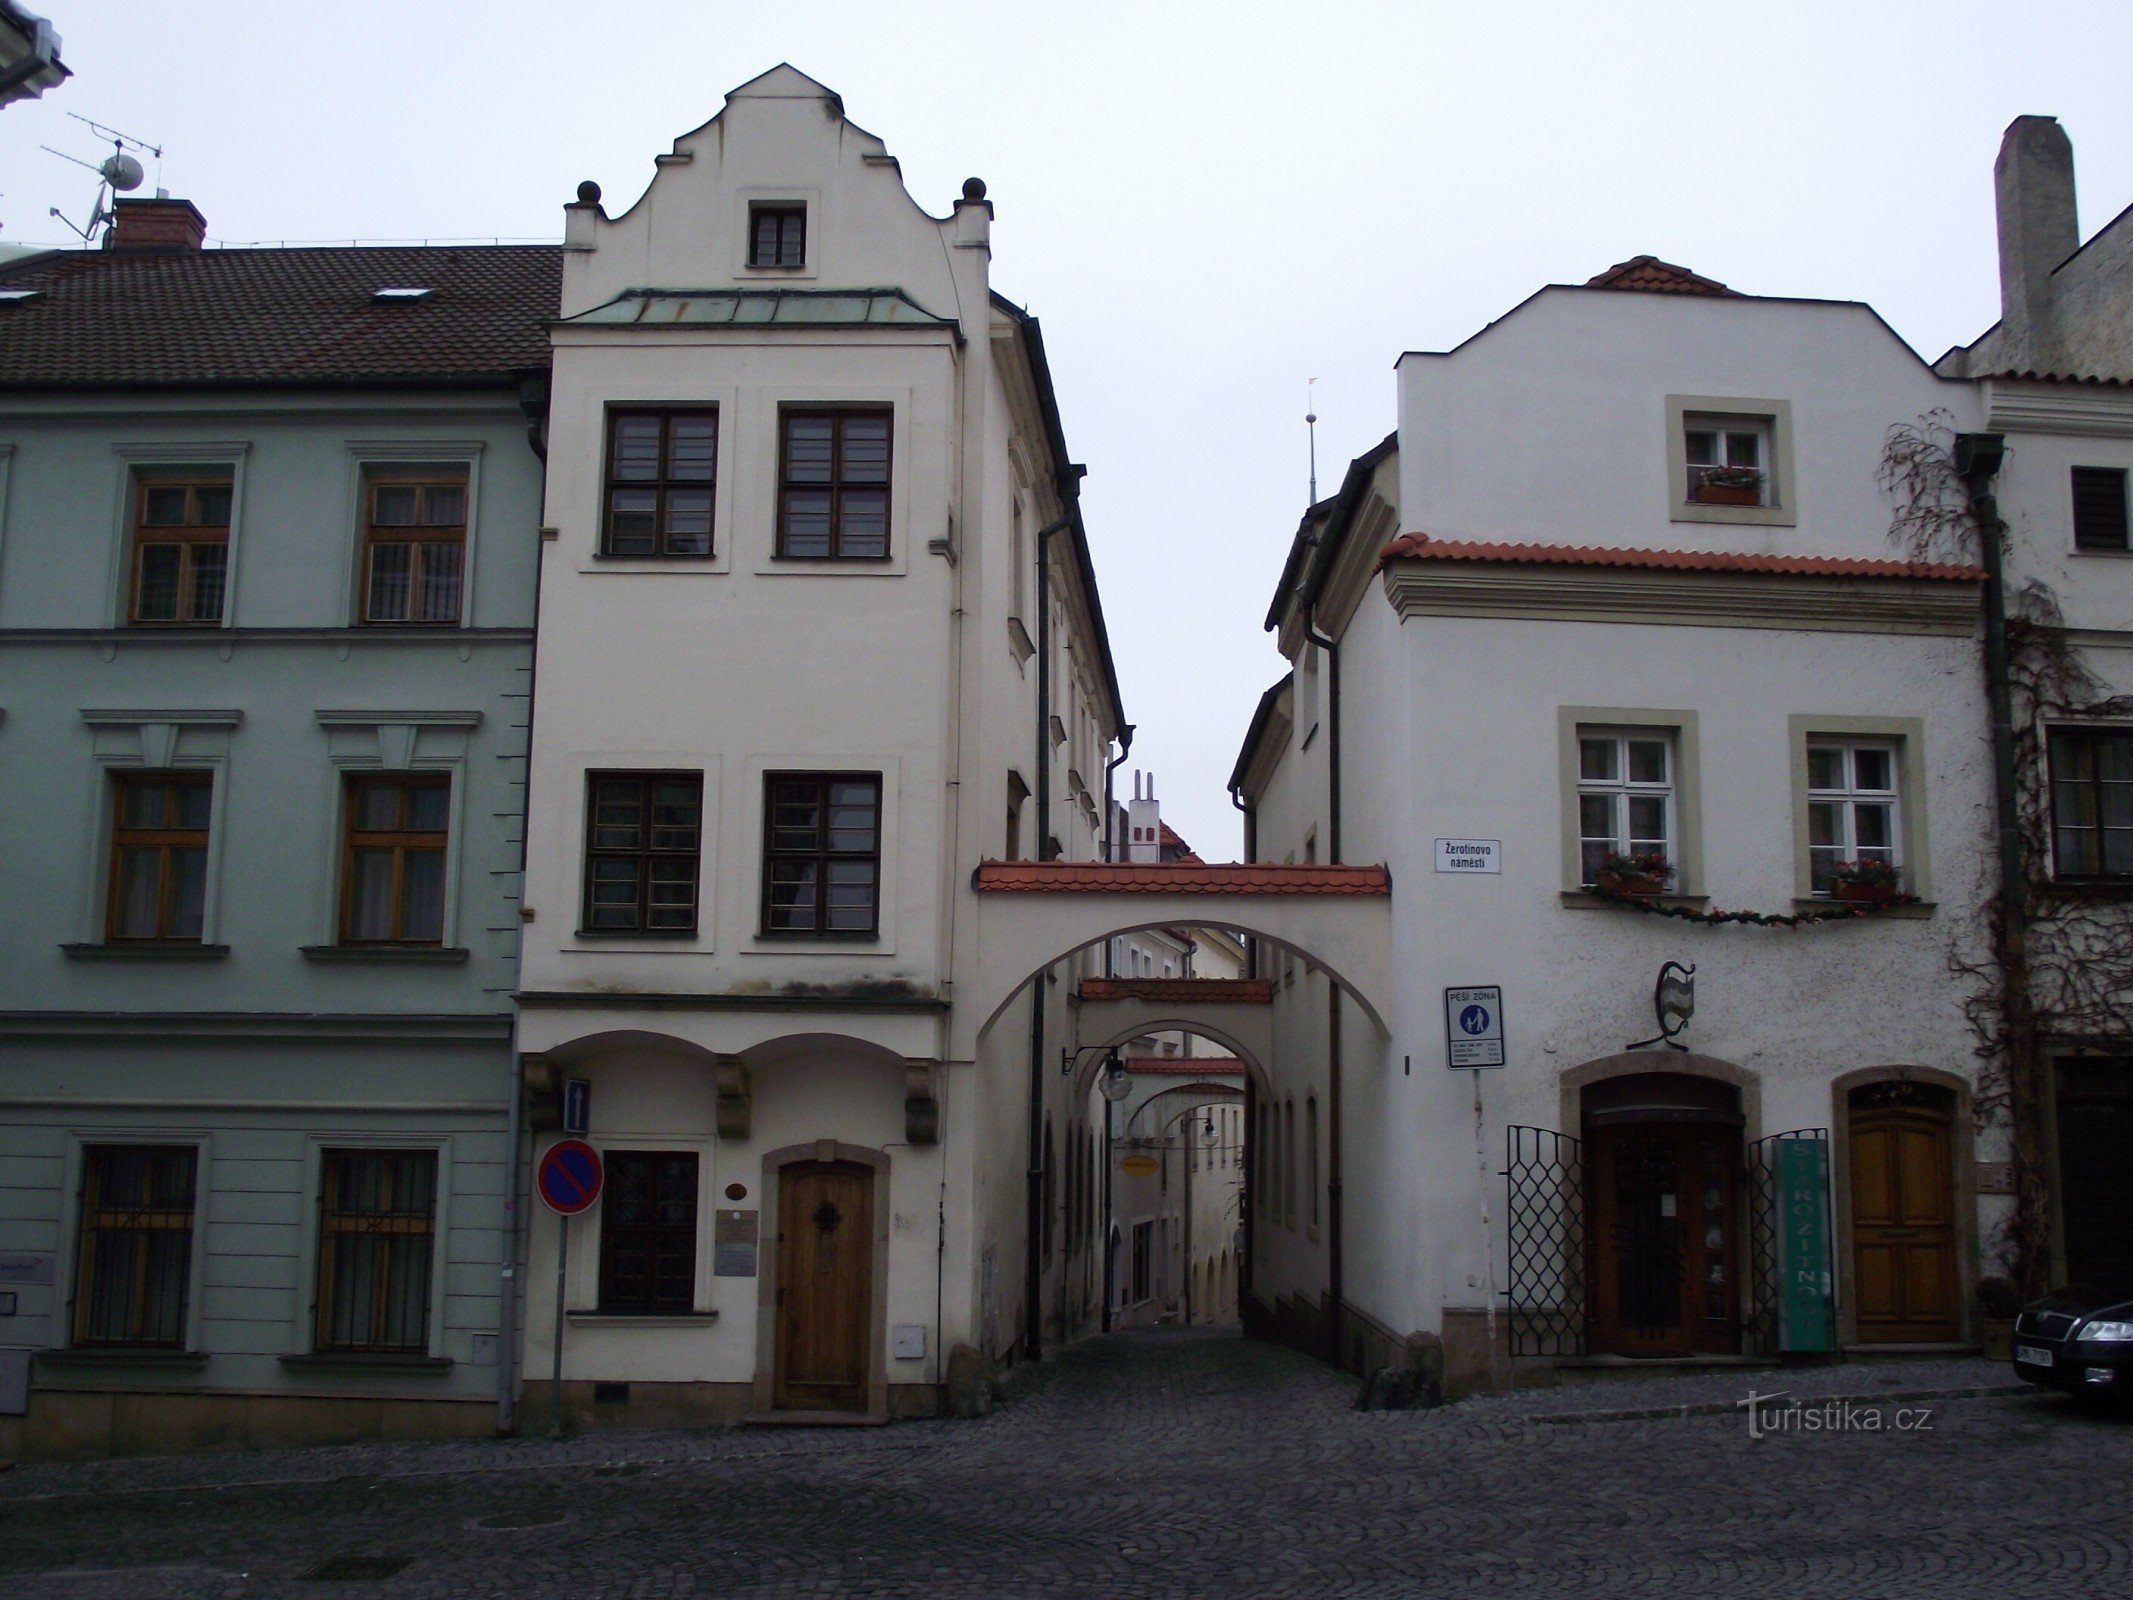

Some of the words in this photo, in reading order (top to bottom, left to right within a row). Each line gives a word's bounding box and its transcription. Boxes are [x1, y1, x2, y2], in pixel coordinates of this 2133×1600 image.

[1445, 841, 1491, 855] Žerotínovo
[1450, 857, 1485, 868] náměstí
[1473, 991, 1496, 1001] ZÓNA
